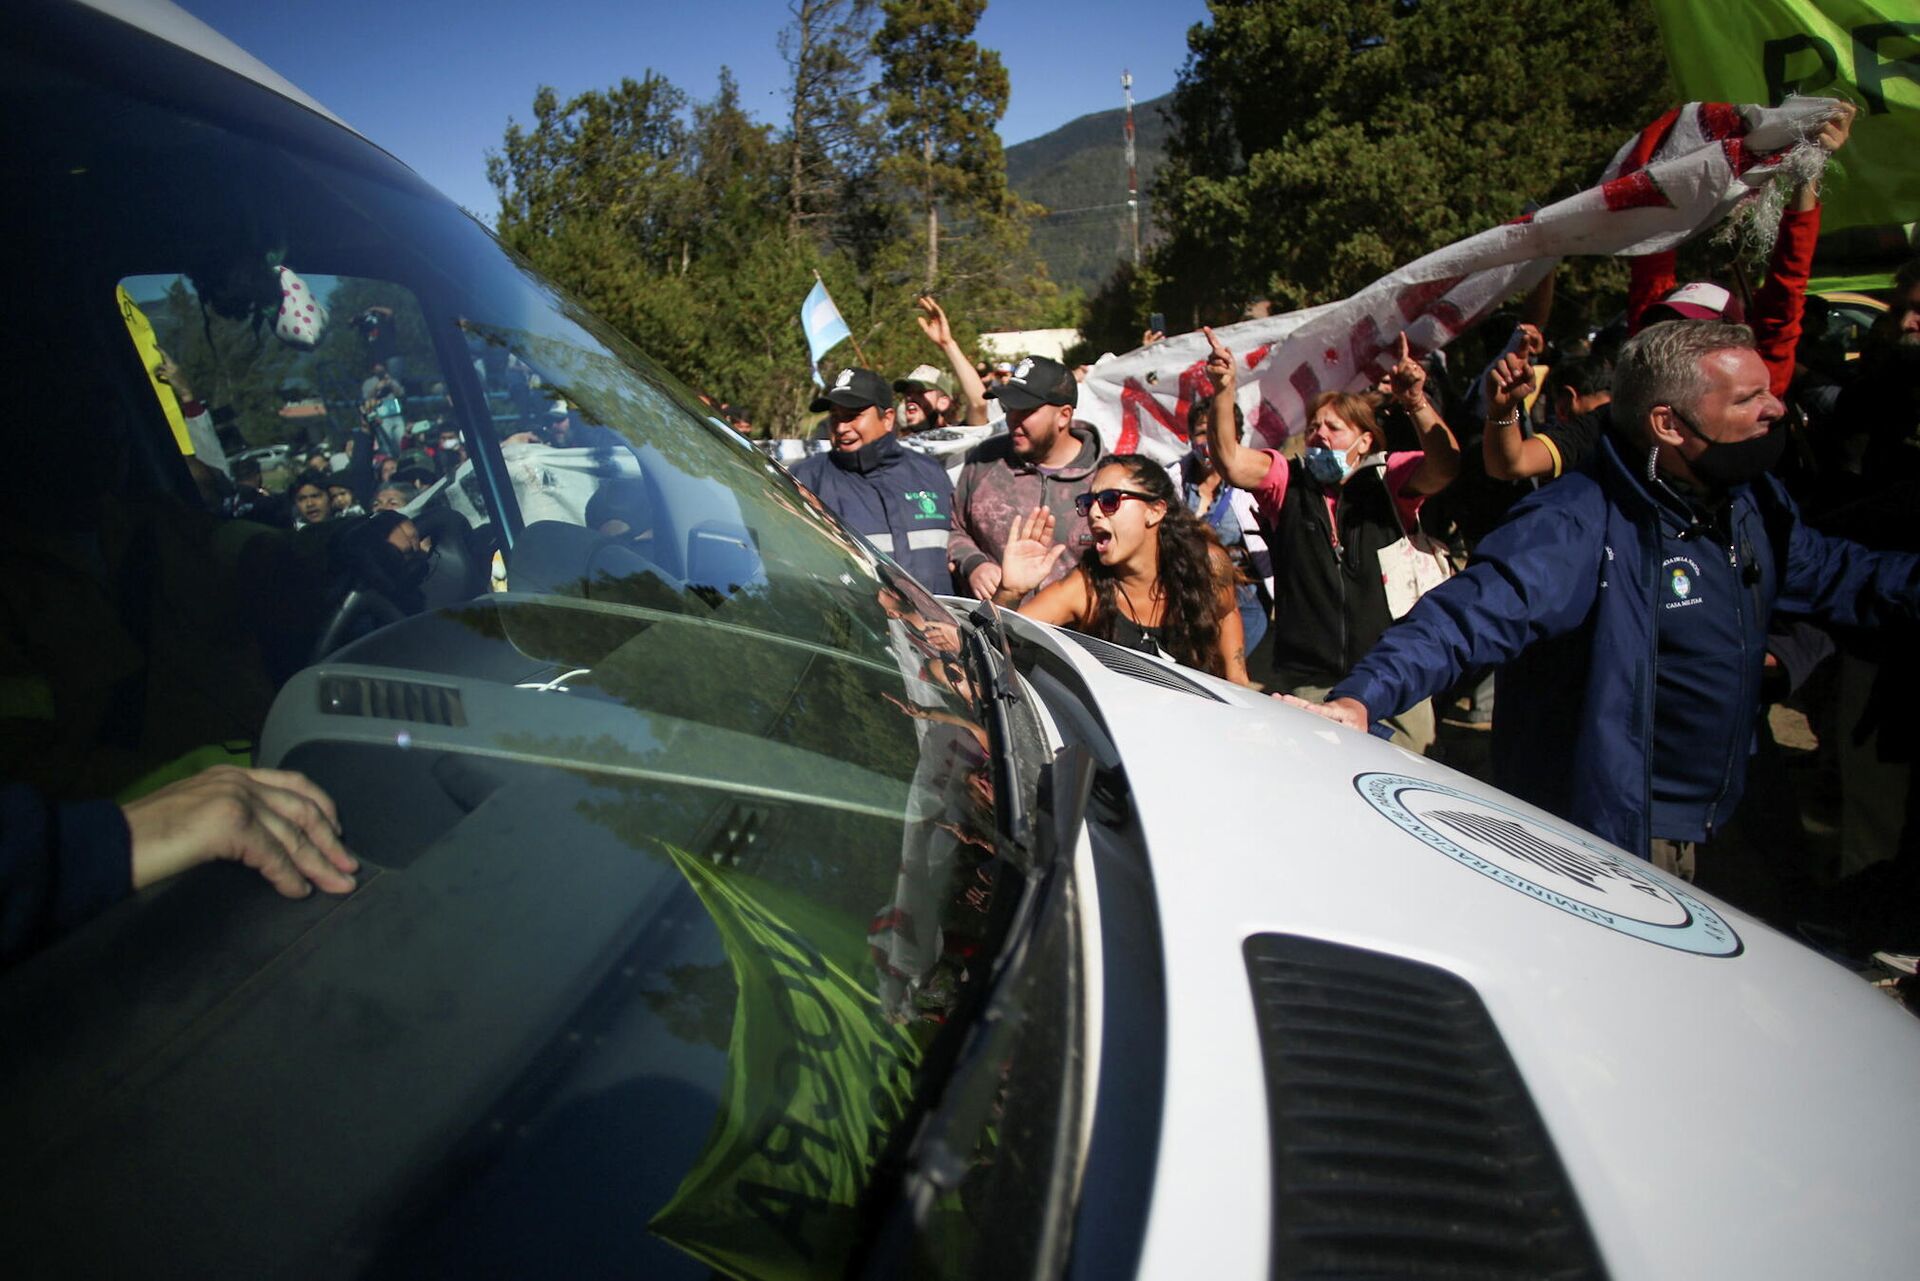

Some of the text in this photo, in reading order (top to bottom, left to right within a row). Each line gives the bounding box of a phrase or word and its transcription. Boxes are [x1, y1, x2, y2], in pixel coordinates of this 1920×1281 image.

[1665, 597, 1703, 610] CASA MILITAR
[1408, 824, 1613, 924] ADMINISTRACION
